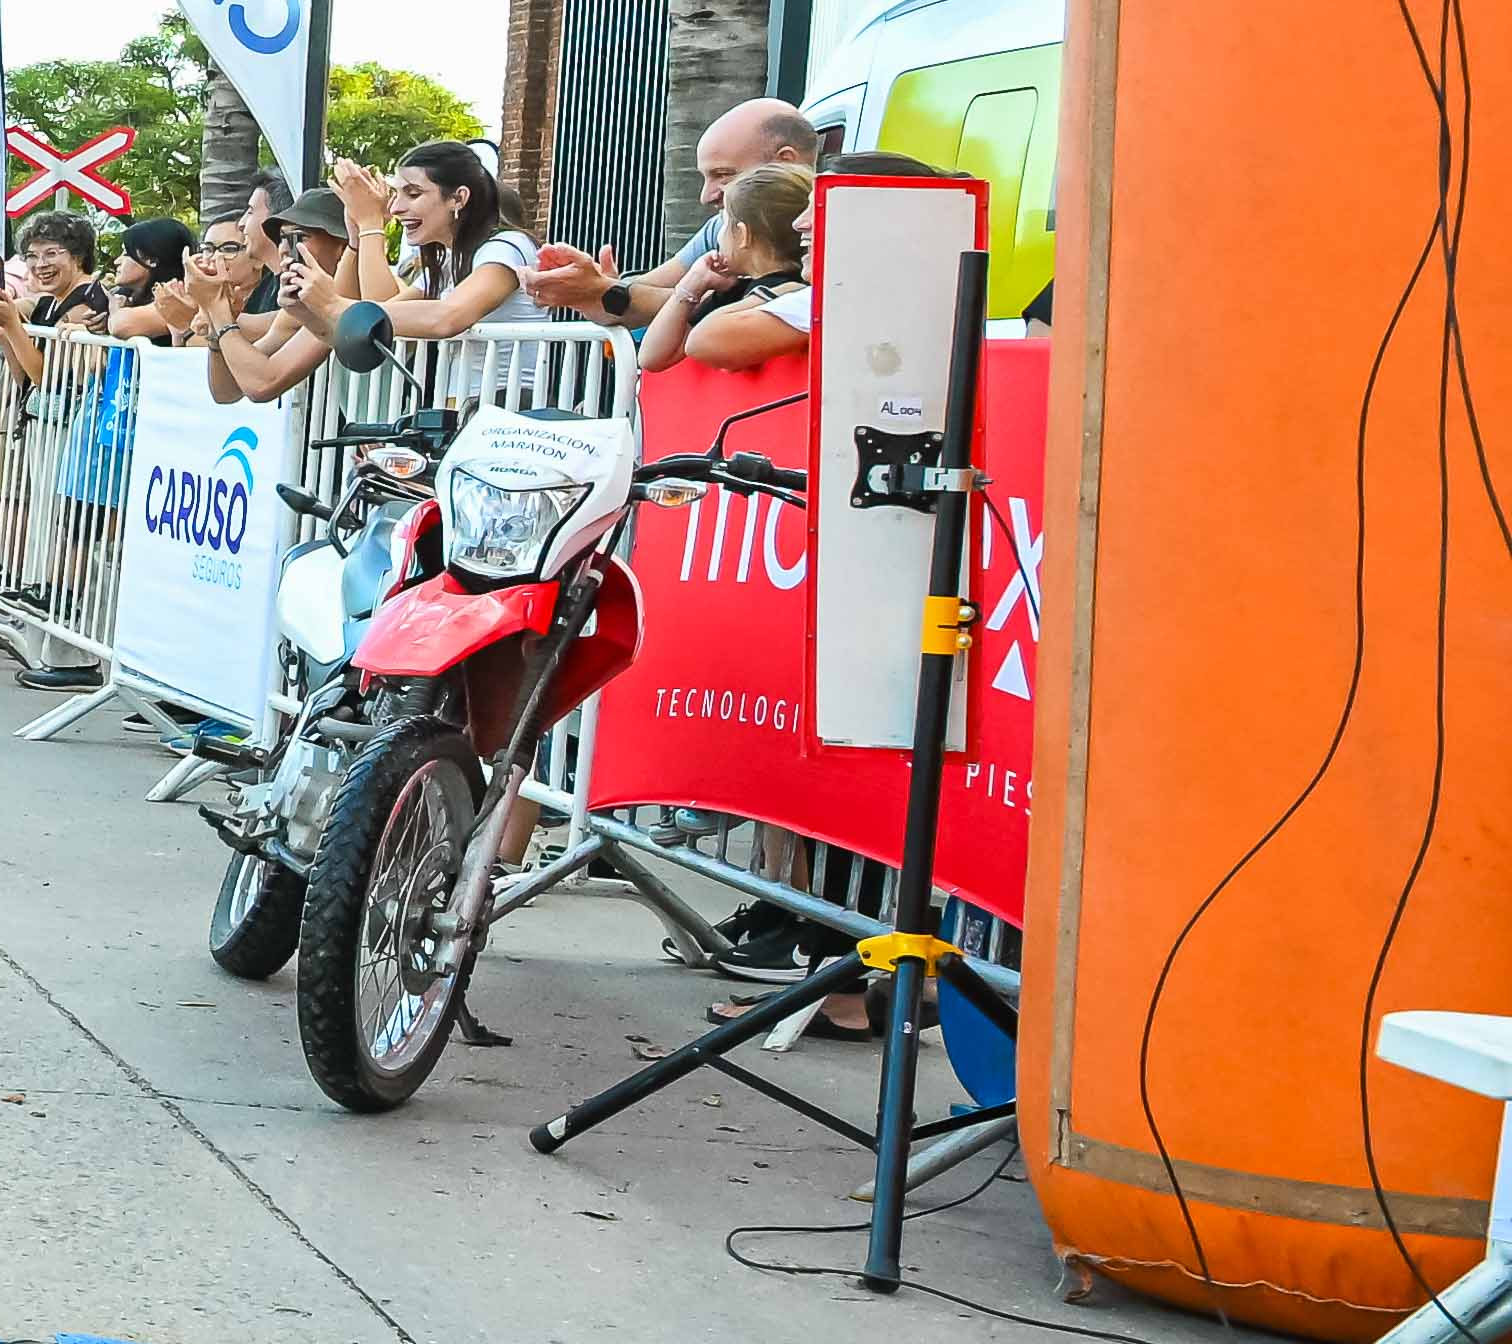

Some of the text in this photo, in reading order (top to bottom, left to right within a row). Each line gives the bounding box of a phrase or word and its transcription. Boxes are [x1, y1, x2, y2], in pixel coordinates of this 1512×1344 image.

[490, 441, 566, 461] MARATON
[489, 467, 538, 476] HONDA
[146, 466, 247, 554] CARUSO
[192, 554, 242, 590] SEGUROS
